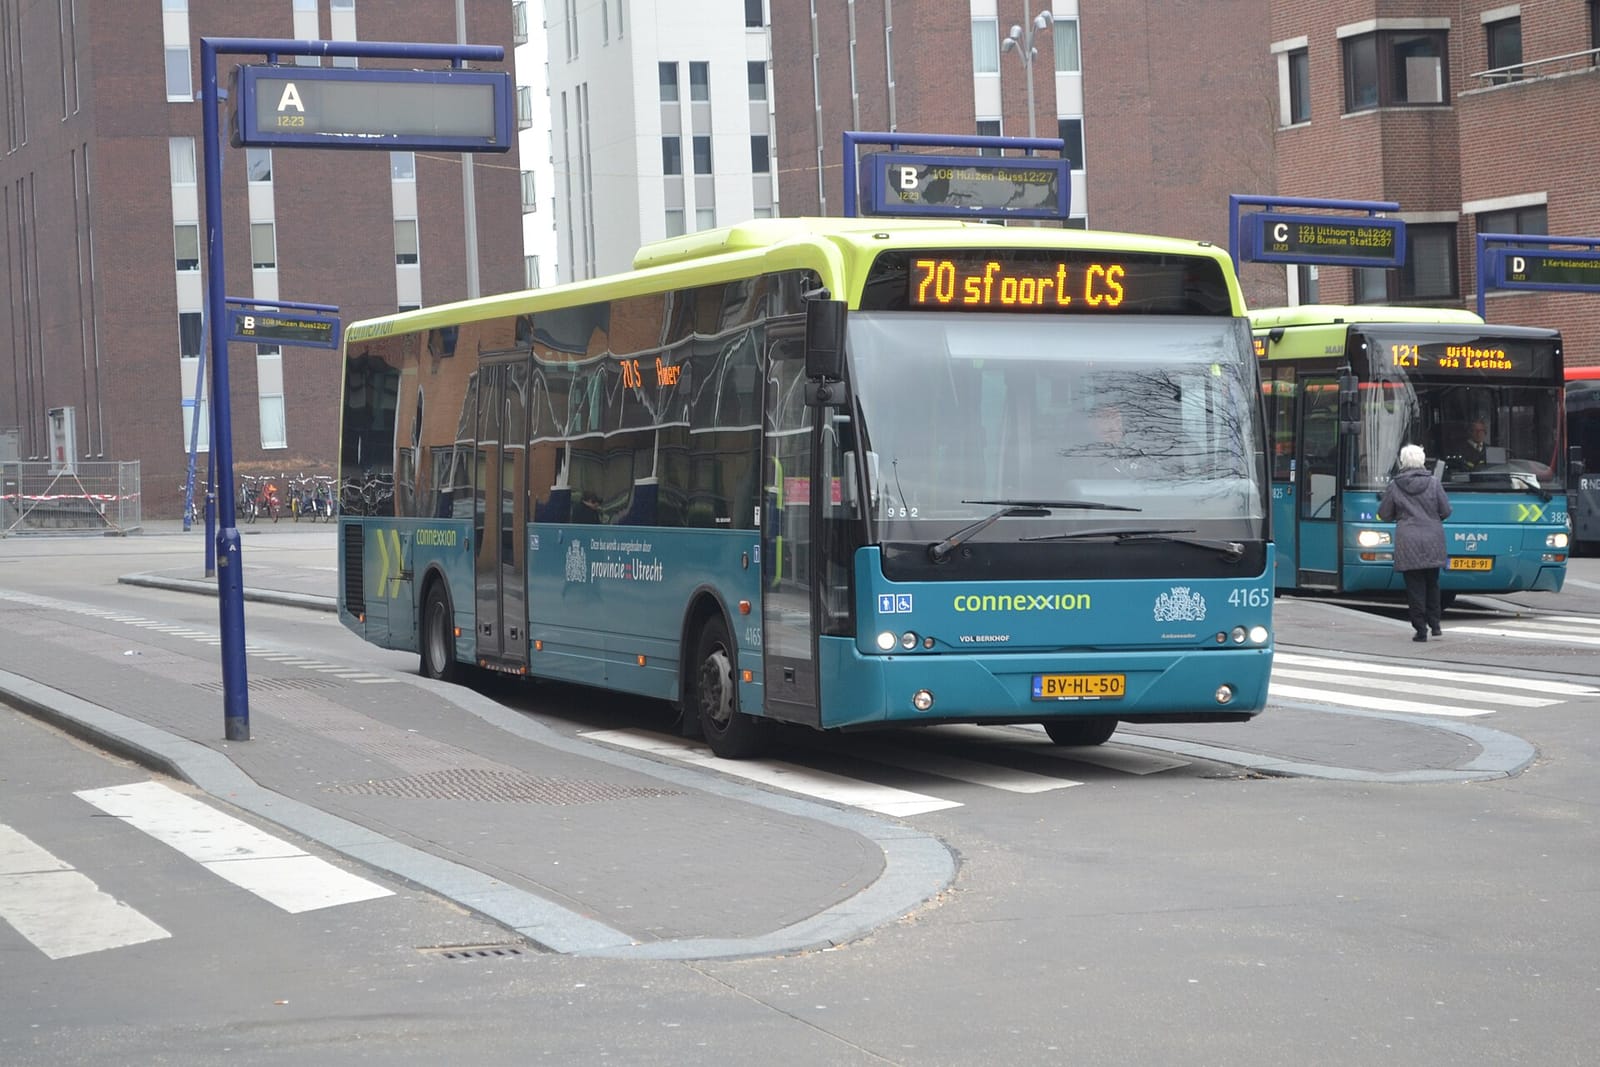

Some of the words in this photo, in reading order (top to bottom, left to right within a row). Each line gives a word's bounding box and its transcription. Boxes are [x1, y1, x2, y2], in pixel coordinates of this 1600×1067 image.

[277, 83, 305, 112] A
[277, 116, 305, 127] 12:23
[900, 167, 919, 189] B
[933, 169, 953, 180] 108
[956, 171, 994, 182] Huizen
[1273, 223, 1288, 242] C
[1298, 226, 1315, 235] 121
[1317, 226, 1356, 237] Uithoorn
[1298, 235, 1315, 244] 109
[1317, 235, 1347, 245] Bussum
[1513, 257, 1526, 273] D
[916, 260, 955, 303] 70
[963, 262, 1071, 306] sfoort
[1085, 264, 1125, 307] CS
[244, 316, 255, 329] B
[1392, 344, 1418, 366] 121
[1447, 346, 1505, 359] Uithoorn
[1440, 357, 1459, 368] via
[1466, 357, 1512, 369] Loenen
[416, 528, 456, 547] connexxion
[1454, 533, 1488, 541] MAN
[229, 544, 237, 552] A
[591, 556, 625, 584] provincie
[631, 557, 663, 583] Utrecht
[1453, 560, 1488, 569] BT-LB-91
[953, 594, 1091, 612] connexxion
[1228, 588, 1270, 608] 4165
[745, 627, 761, 646] 4165
[960, 635, 975, 643] VDL
[1047, 678, 1120, 693] BV-HL-50
